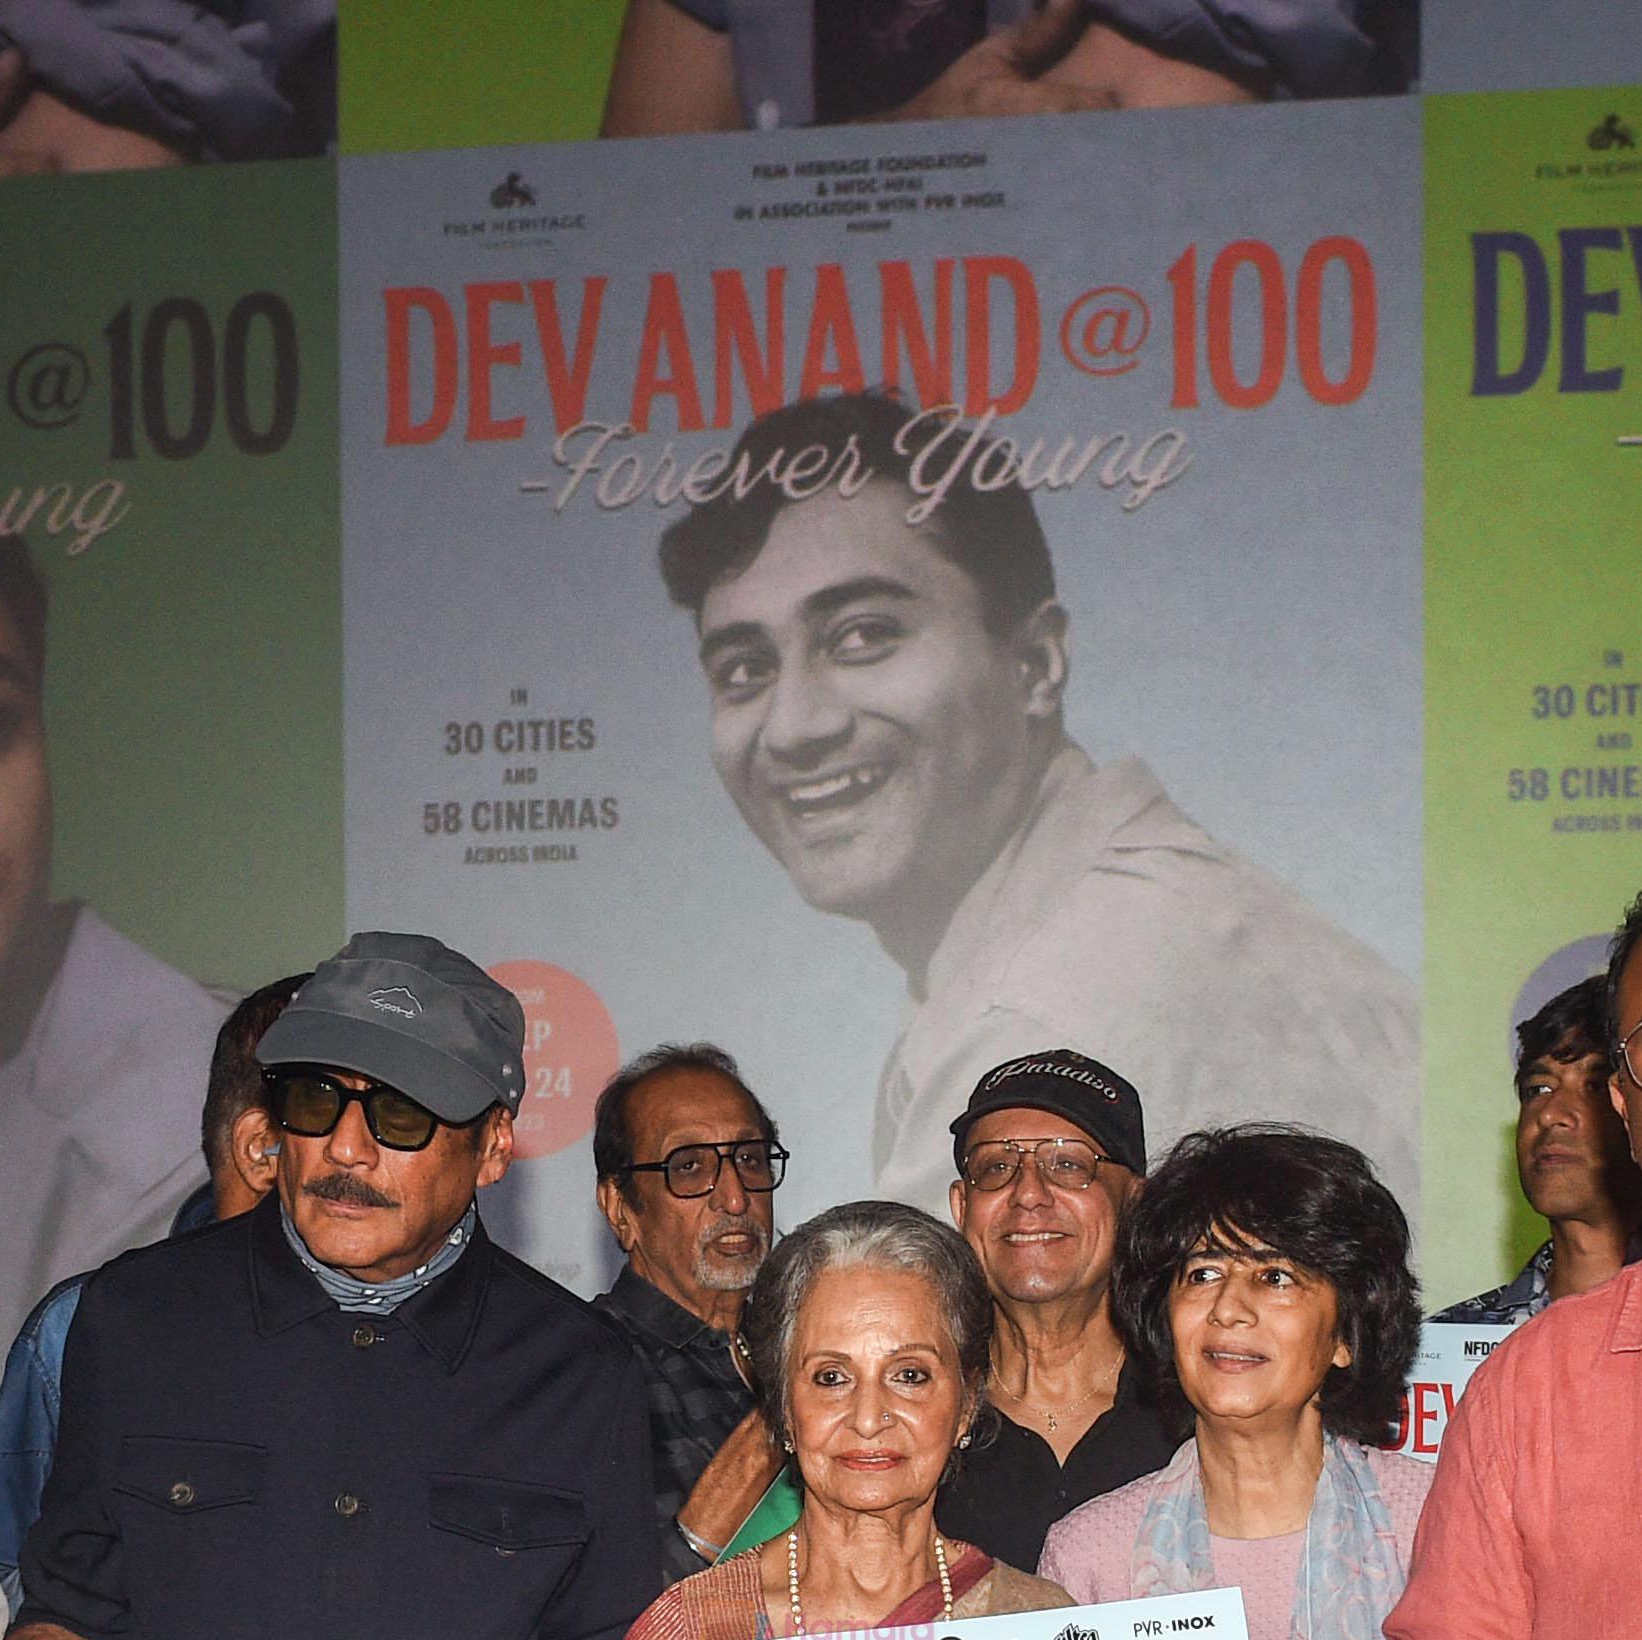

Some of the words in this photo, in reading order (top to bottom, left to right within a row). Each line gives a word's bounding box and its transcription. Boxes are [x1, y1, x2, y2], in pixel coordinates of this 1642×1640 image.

[443, 218, 486, 238] FILM
[492, 213, 586, 235] HERITAGE
[382, 276, 607, 446] DEV
[630, 254, 1040, 433] ANAND
[1059, 285, 1150, 376] @
[1166, 235, 1378, 411] 100
[7, 342, 91, 430] @
[103, 292, 298, 461] 100
[894, 405, 1195, 525] Young
[1532, 684, 1576, 720] 30
[444, 722, 483, 755] 30
[494, 717, 596, 751] CITIES
[1508, 766, 1551, 801] 58
[422, 801, 461, 835] 58
[470, 797, 619, 832] CINEMAS
